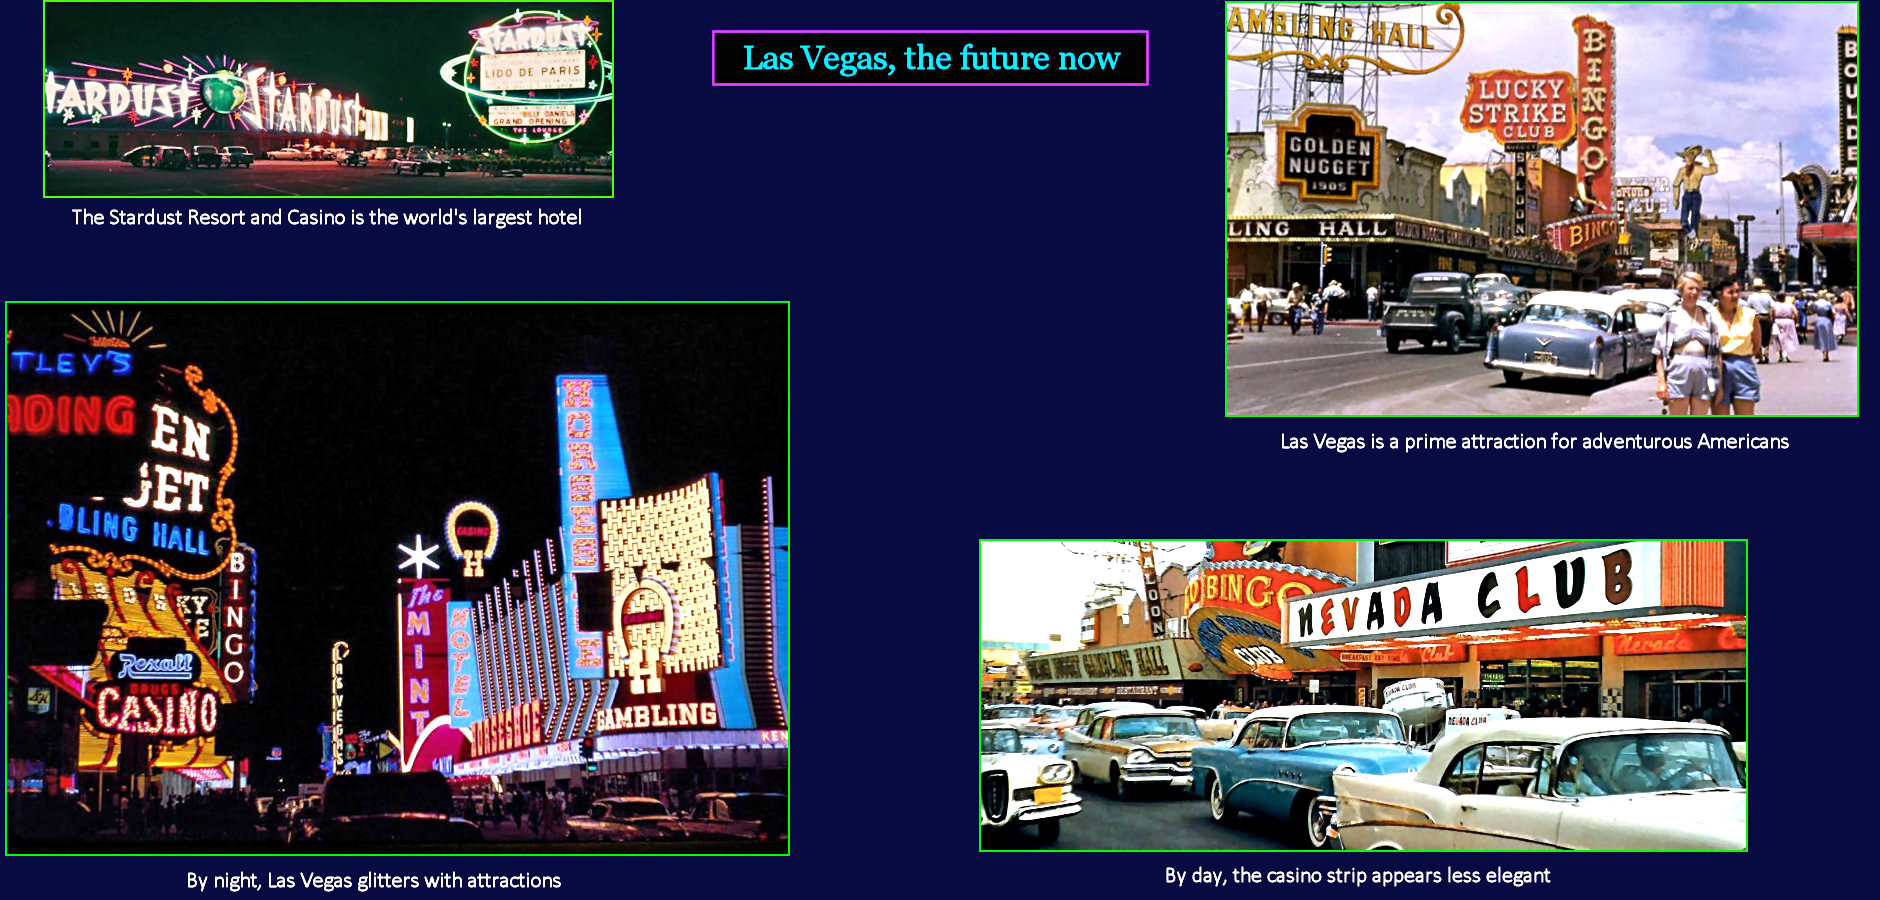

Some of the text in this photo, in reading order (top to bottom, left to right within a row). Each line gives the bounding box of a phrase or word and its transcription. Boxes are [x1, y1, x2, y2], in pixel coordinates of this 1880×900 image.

[476, 23, 591, 54] STARDUST
[1227, 7, 1434, 49] AMBLING HALL
[485, 66, 580, 78] LIDO DE PARIS
[243, 67, 364, 136] STARDUST
[1480, 80, 1564, 100] LUCKY
[1582, 28, 1607, 171] BINGO
[1844, 40, 1857, 160] BOULDE
[1469, 104, 1566, 124] STRIKE
[1290, 137, 1371, 156] GOLDEN
[1503, 126, 1555, 138] CLUB
[1289, 158, 1370, 176] NUGGET
[1312, 181, 1347, 191] 1905
[1516, 152, 1525, 234] SALOON
[1228, 221, 1388, 237] LING HALL
[1570, 218, 1617, 249] BINGO
[12, 351, 132, 375] TLEY'S
[151, 403, 210, 462] EN
[58, 503, 210, 557] BLING HALL
[561, 379, 603, 669] HORSESE
[407, 584, 444, 608] The
[1140, 541, 1166, 634] SALOON
[1207, 574, 1313, 608] BINGO
[1298, 549, 1633, 637] NEVADA CLUB
[224, 552, 245, 684] BINGO
[1233, 644, 1285, 666] CLUB
[1421, 643, 1456, 662] Club
[1619, 631, 1692, 652] Nevada
[118, 653, 194, 679] Rexall
[336, 648, 344, 690] LAS
[406, 611, 431, 737] MINT
[450, 608, 470, 718] HOTEL
[1134, 645, 1170, 677] HALL
[130, 683, 180, 695] DRUGS
[1117, 686, 1159, 695] RESTAURANT
[97, 687, 218, 736] CASINO
[597, 702, 718, 732] GAMBLING
[336, 695, 344, 766] VEGAS
[470, 698, 542, 758] HORSESHOE
[762, 731, 788, 743] KEN
